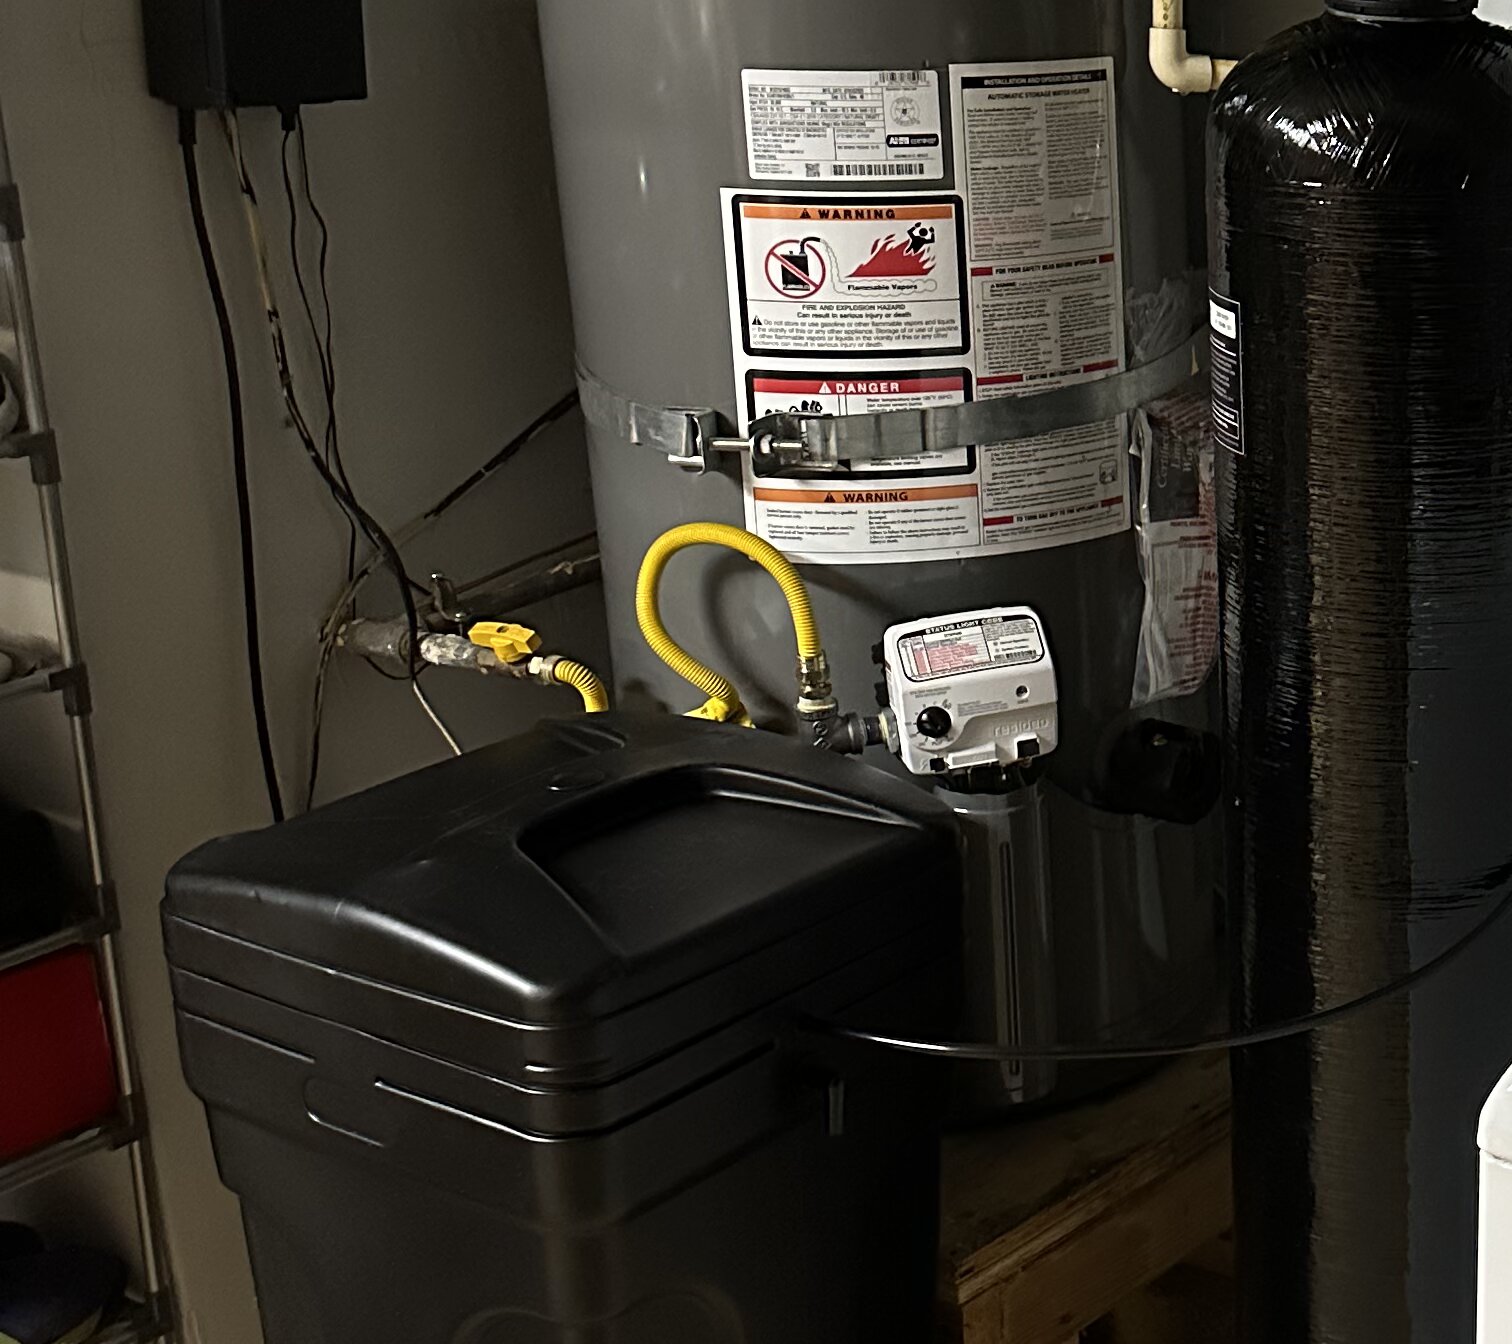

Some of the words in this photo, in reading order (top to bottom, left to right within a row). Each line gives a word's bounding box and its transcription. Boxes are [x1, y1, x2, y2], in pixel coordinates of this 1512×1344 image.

[817, 208, 896, 220] WARNING
[835, 382, 900, 393] DANGER
[843, 491, 908, 503] WARNING
